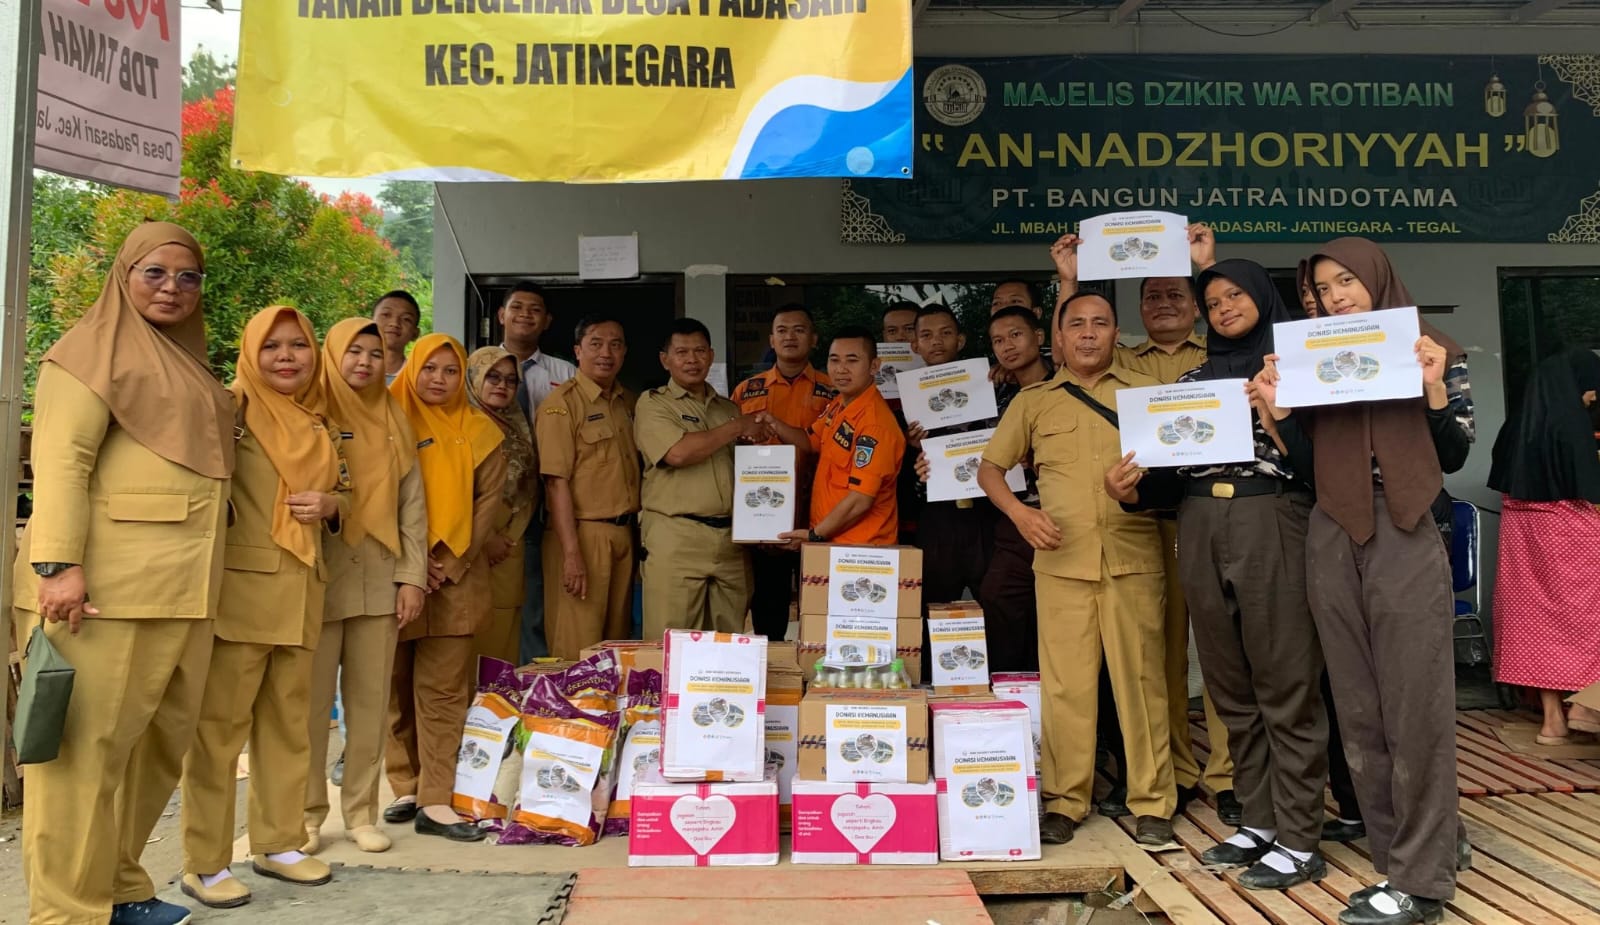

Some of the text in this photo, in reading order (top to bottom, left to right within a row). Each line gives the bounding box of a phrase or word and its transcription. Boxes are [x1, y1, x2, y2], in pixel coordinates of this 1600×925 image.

[425, 42, 736, 89] KEC. JATINEGARA
[1003, 81, 1454, 107] MAJELIS DZIKIR WA ROTIBAIN
[957, 132, 1489, 168] AN-NADZHORIYYAH
[992, 187, 1458, 208] PT. BANGUN JATRA INDOTAMA
[992, 222, 1015, 235] JL.
[1020, 222, 1068, 234] MBAH
[1291, 221, 1393, 233] JATINEGARA
[1406, 222, 1462, 234] TEGAL
